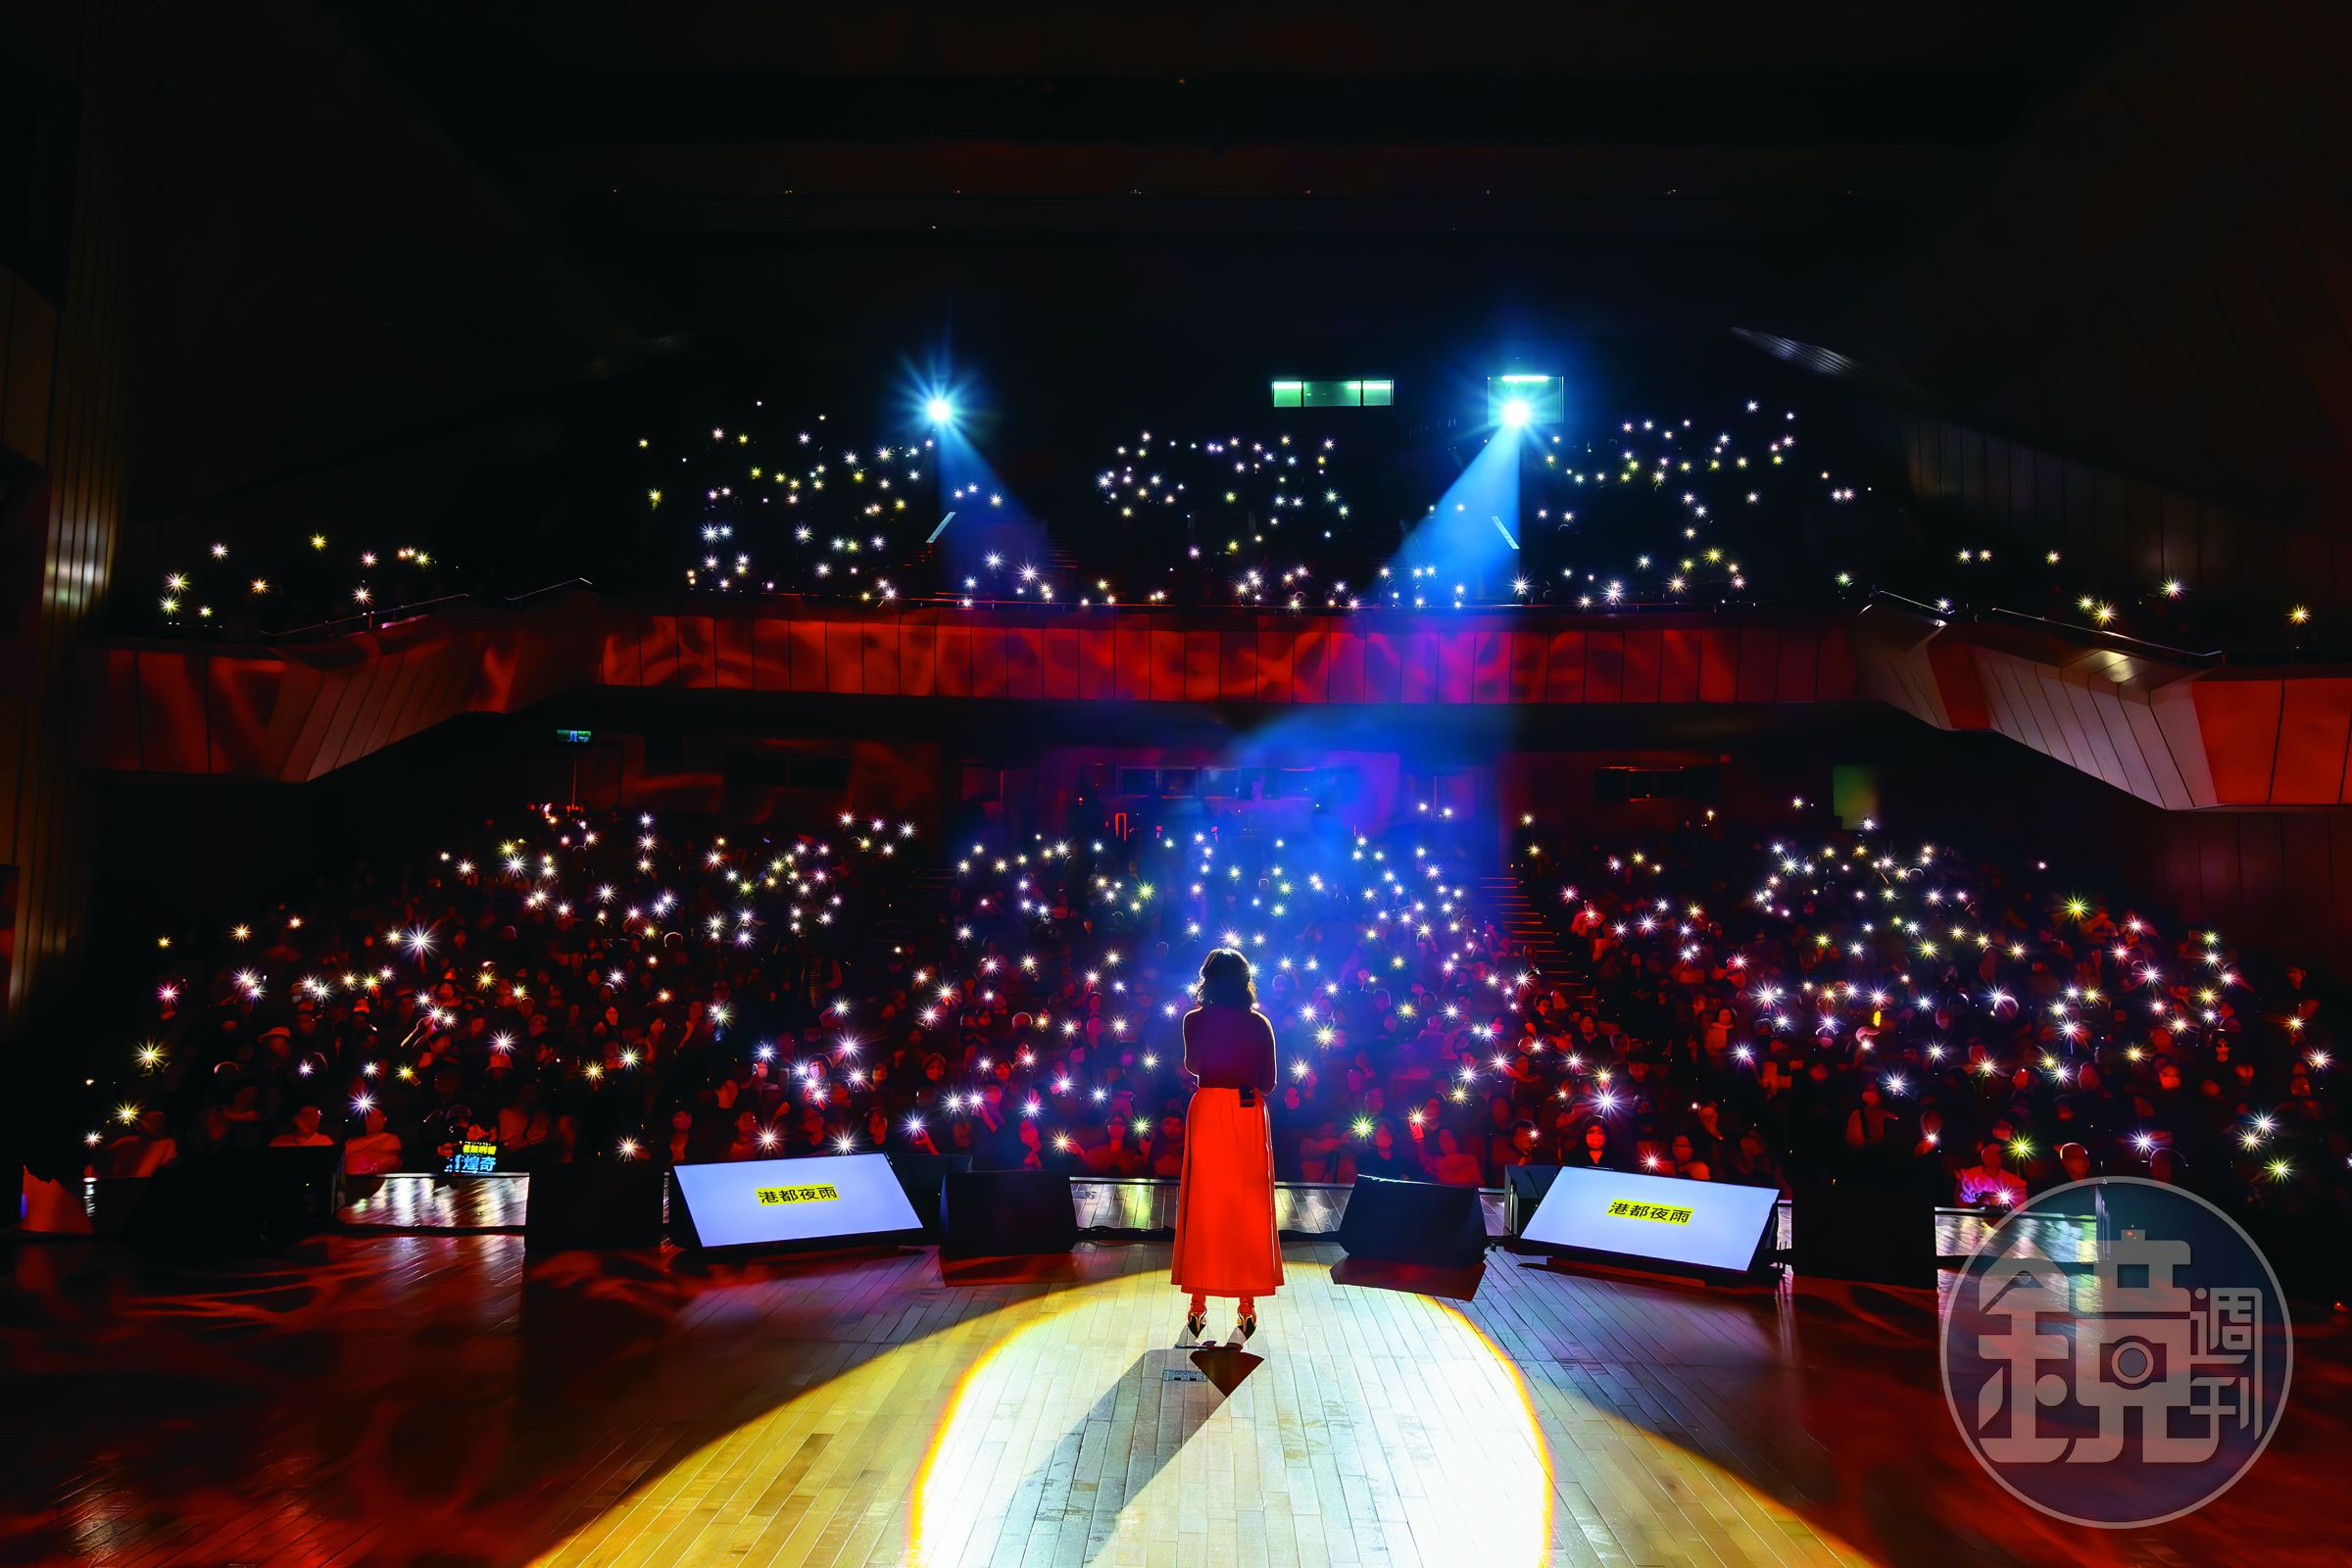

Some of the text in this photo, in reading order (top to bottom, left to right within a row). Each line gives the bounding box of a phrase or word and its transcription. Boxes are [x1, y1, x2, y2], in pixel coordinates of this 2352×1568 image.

[758, 1187, 838, 1203] 港都夜雨
[1608, 1201, 1692, 1223] 港都夜雨
